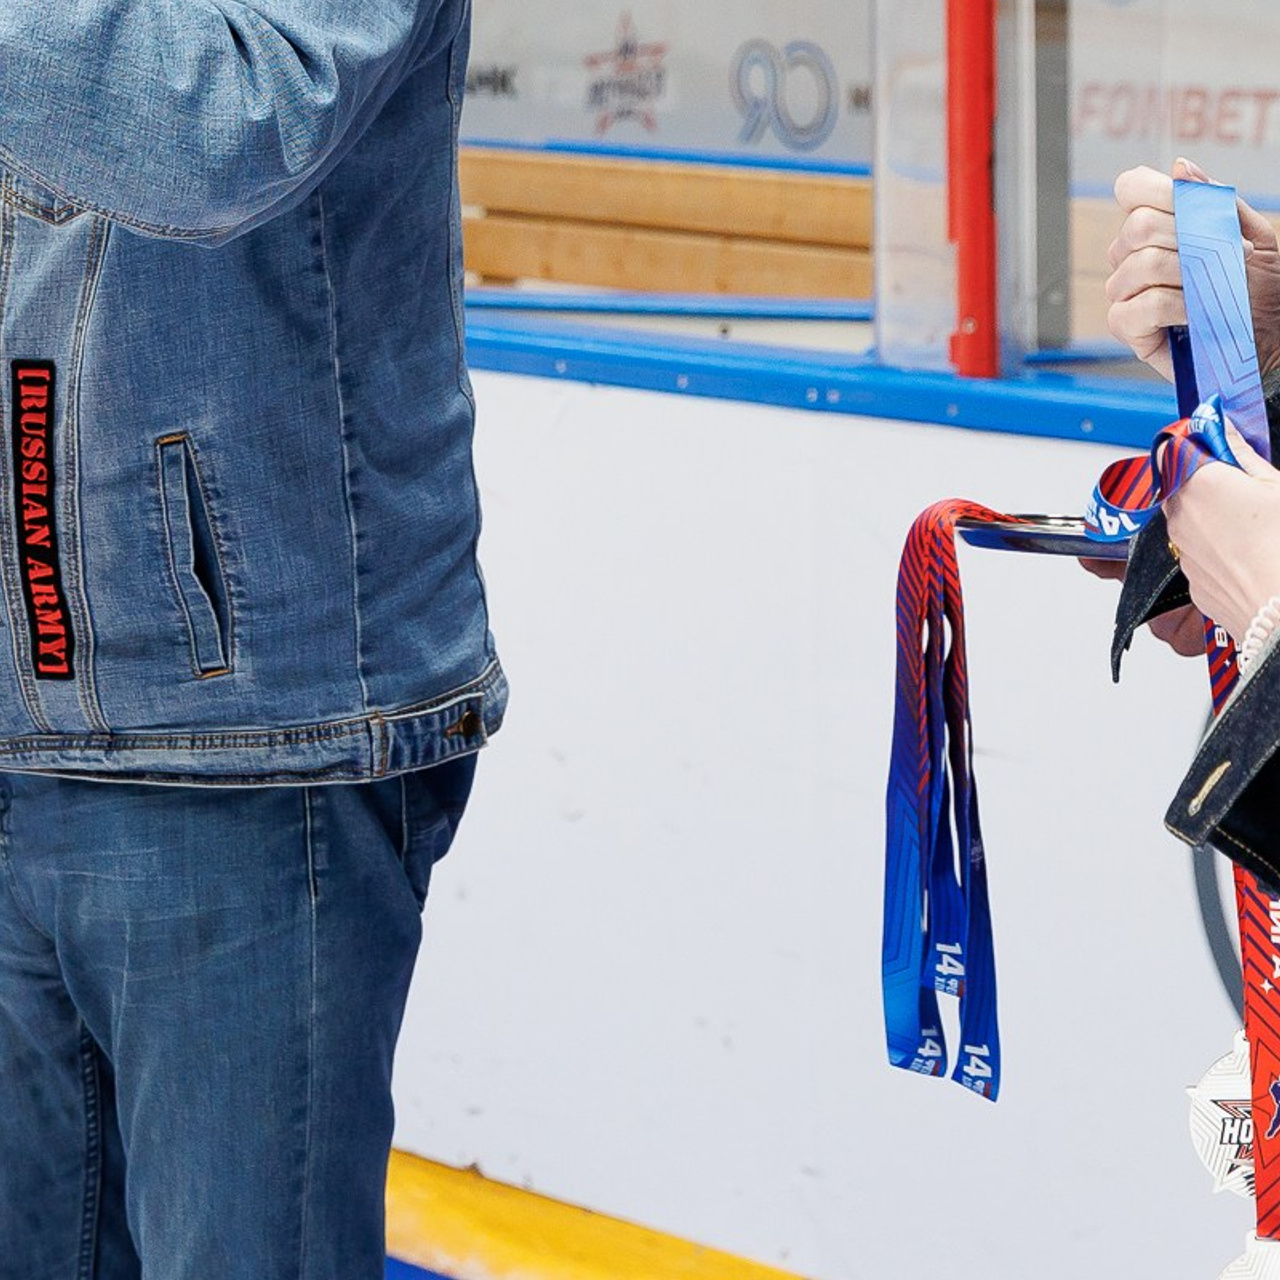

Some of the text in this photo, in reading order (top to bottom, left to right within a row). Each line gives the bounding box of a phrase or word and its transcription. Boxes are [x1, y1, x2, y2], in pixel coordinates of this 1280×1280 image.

[1073, 78, 1280, 145] FONBET
[935, 942, 966, 977] 14
[917, 1025, 943, 1058] 14
[963, 1044, 993, 1079] 14
